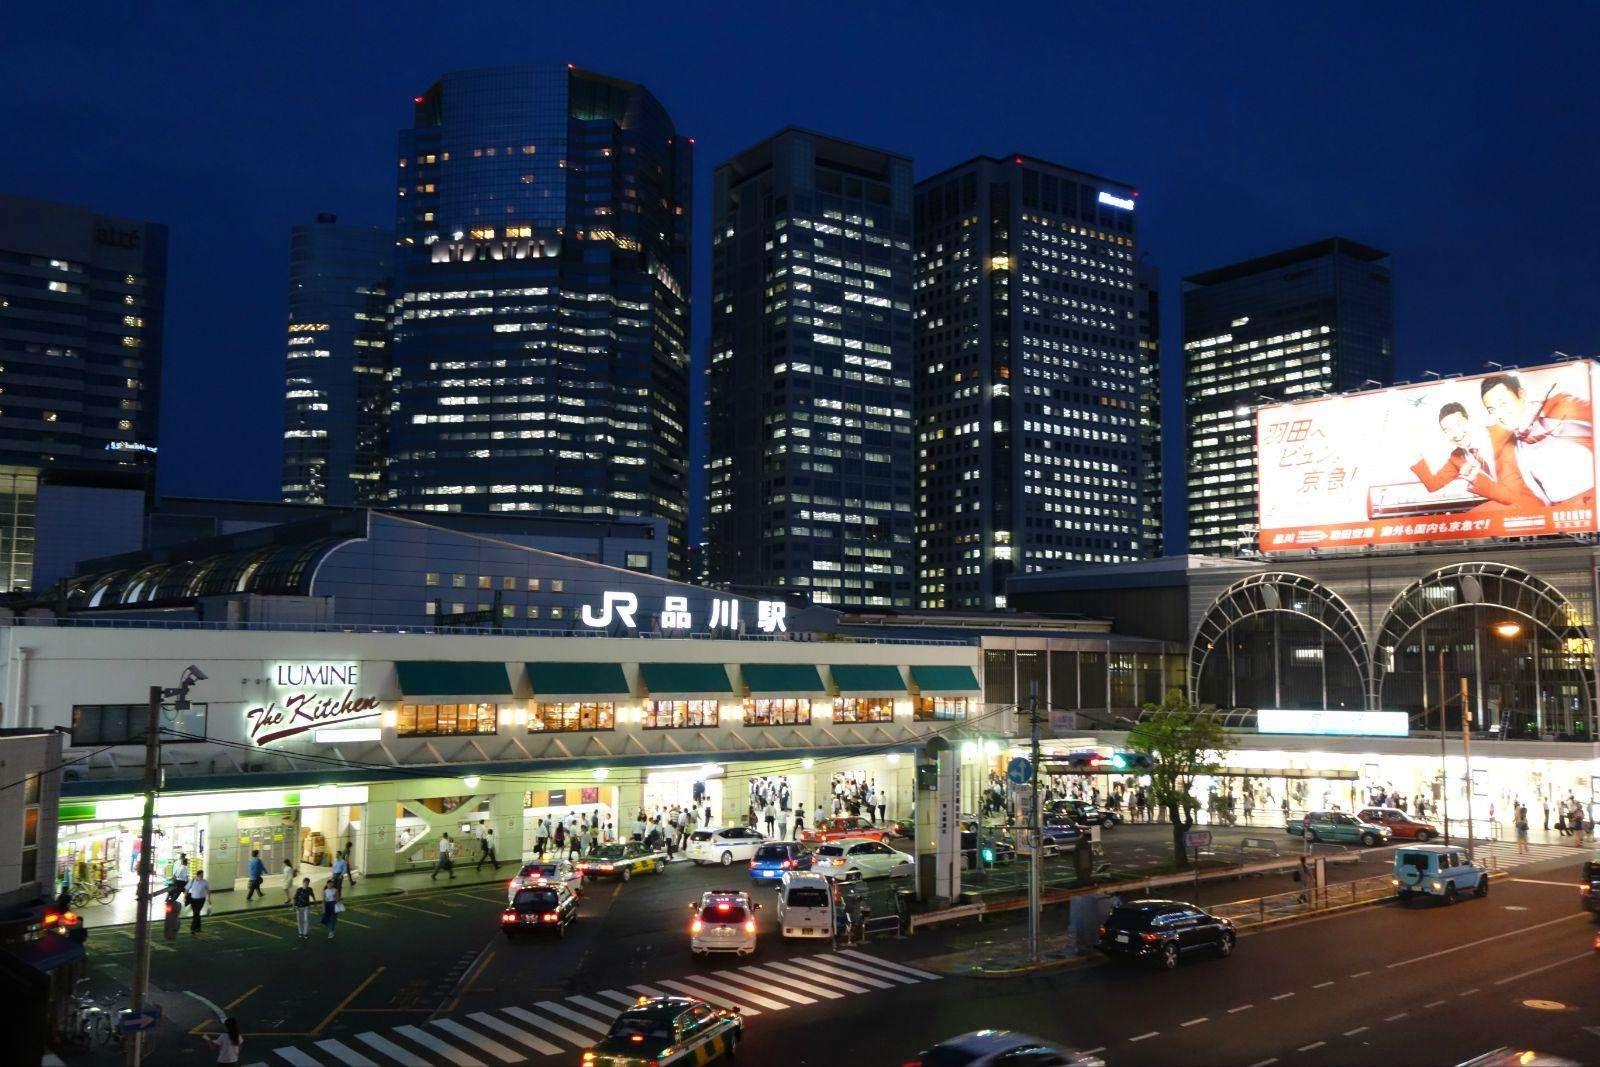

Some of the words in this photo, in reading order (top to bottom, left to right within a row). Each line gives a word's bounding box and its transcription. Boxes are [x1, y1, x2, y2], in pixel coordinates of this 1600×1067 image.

[582, 591, 638, 628] JR
[661, 596, 787, 632] 品川駅
[278, 665, 358, 685] LUMINE
[247, 703, 284, 738] The
[286, 688, 380, 724] Kitchen
